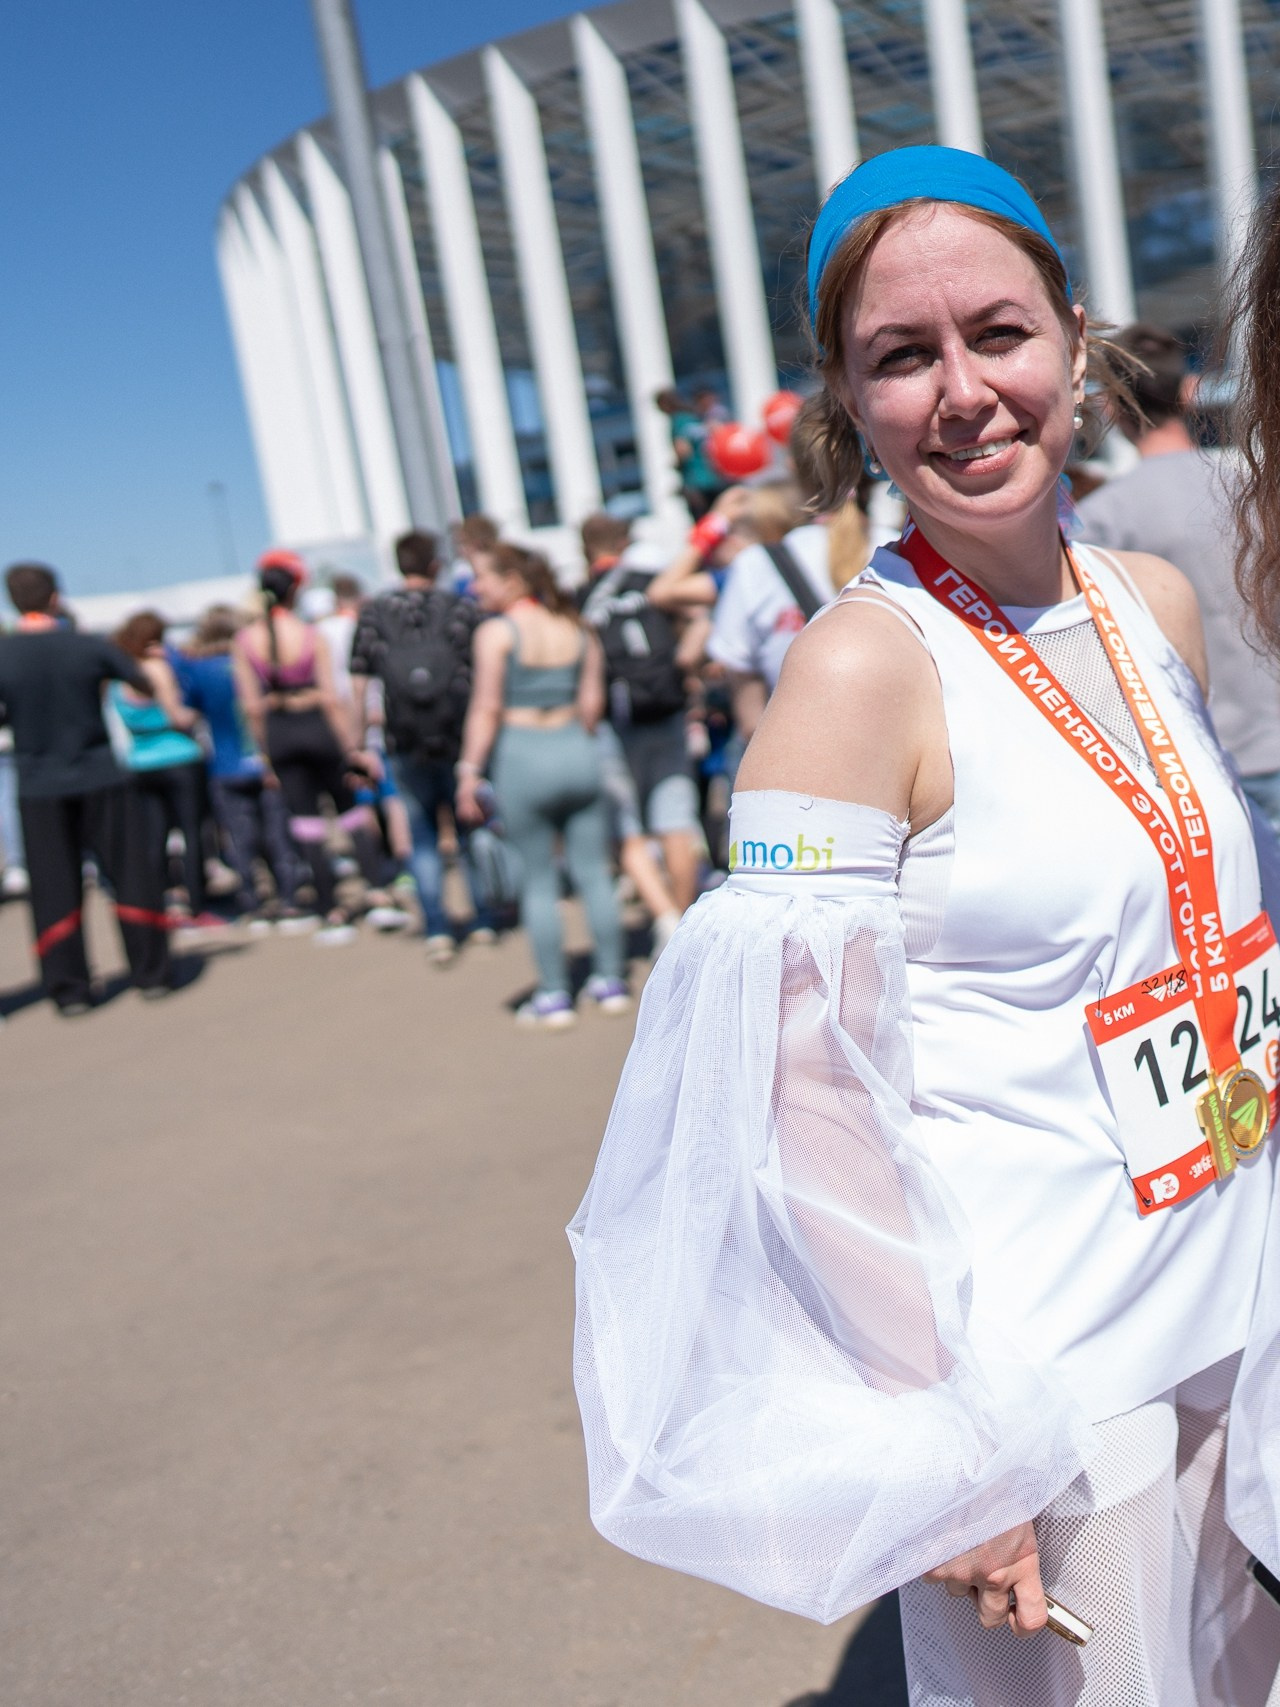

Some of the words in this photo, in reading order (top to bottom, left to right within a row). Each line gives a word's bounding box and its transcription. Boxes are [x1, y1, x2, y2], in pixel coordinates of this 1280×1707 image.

[933, 569, 1020, 664] ГЕРОИ
[1018, 661, 1135, 788] МЕНЯЮТ
[1131, 793, 1186, 874] ЭТОТ
[1097, 612, 1170, 746] МЕНЯЮТ
[743, 834, 835, 870] mobi
[1158, 752, 1208, 858] ГЕРОИ
